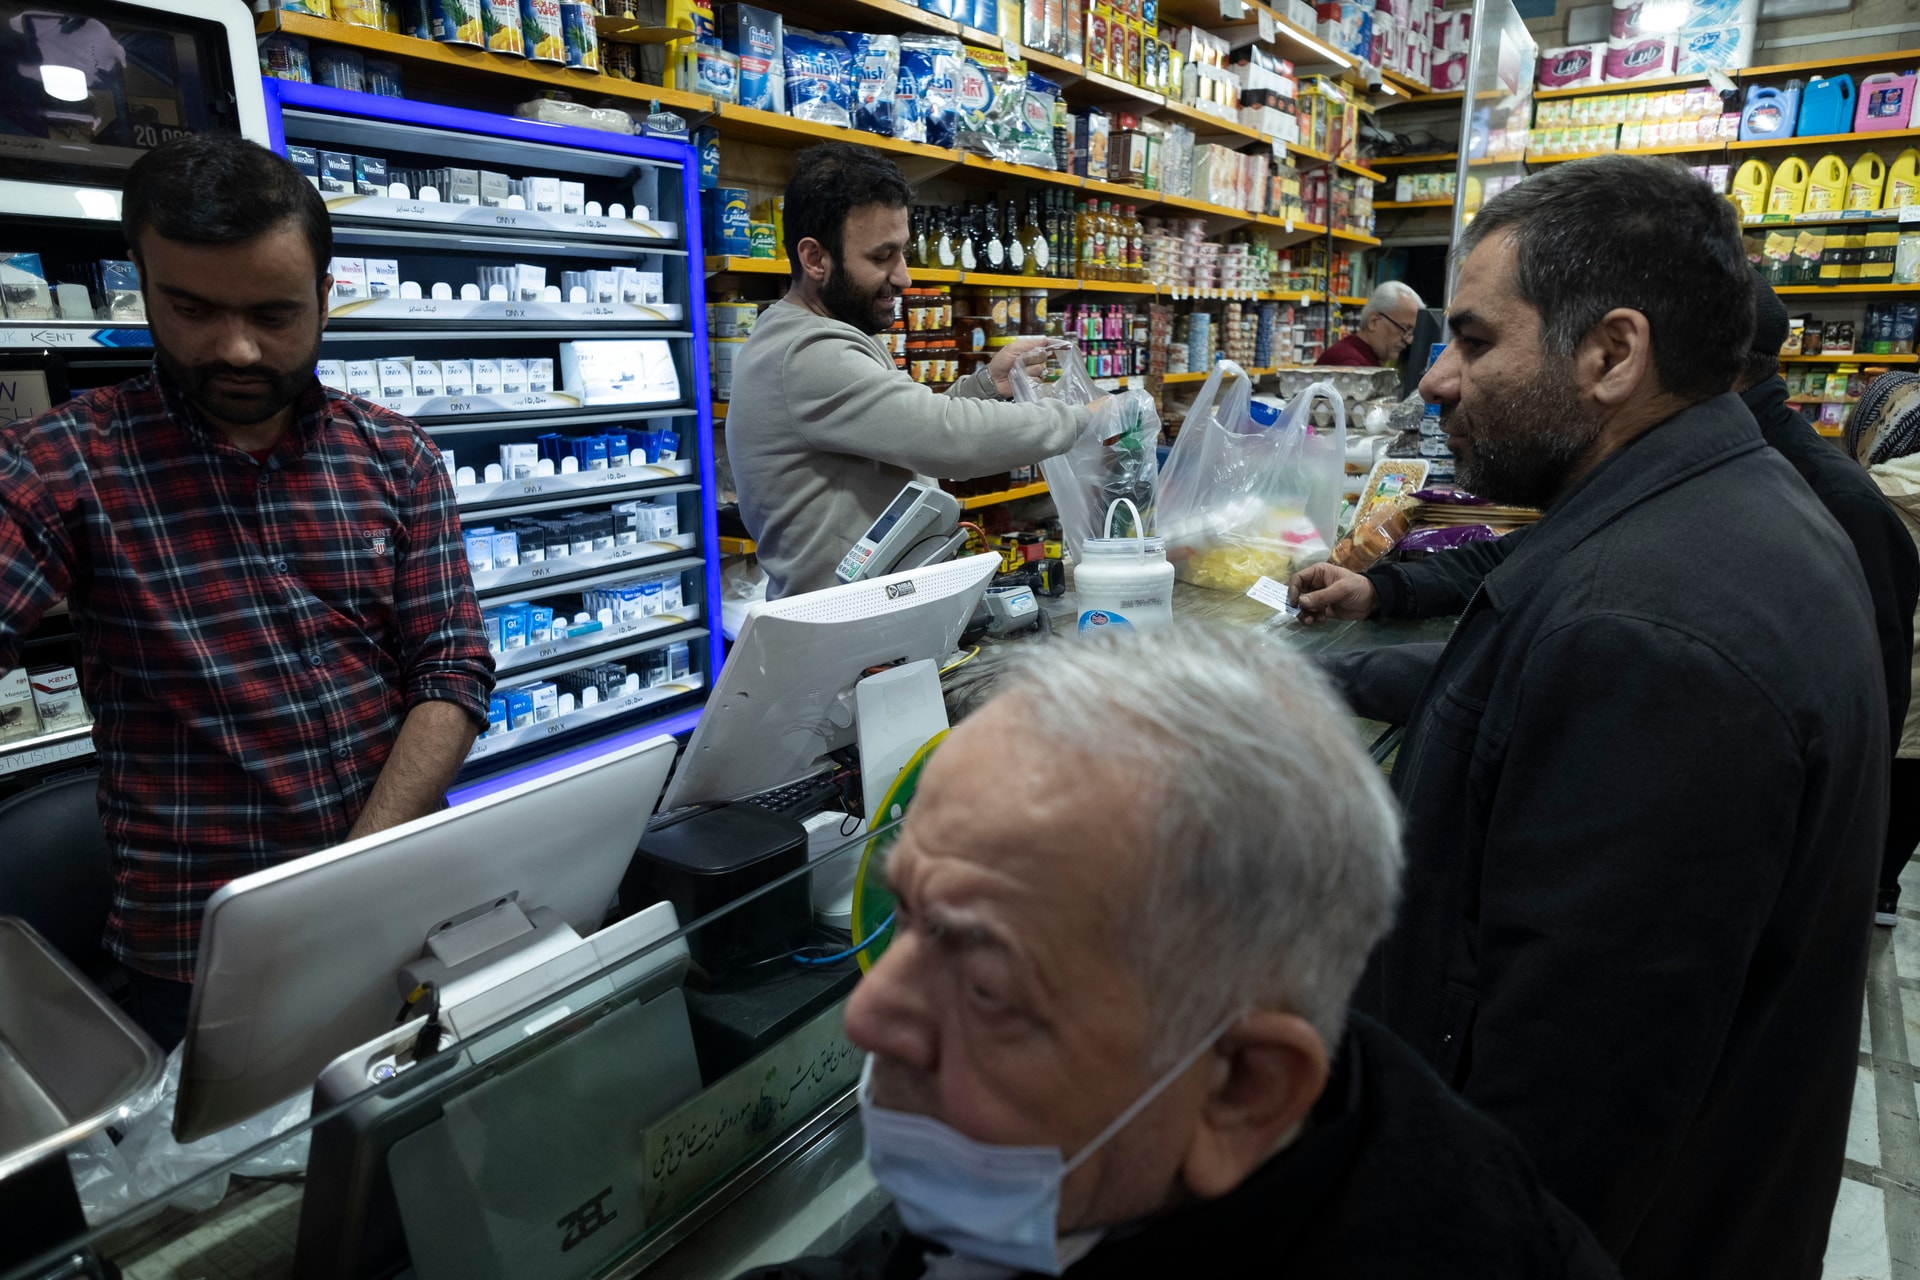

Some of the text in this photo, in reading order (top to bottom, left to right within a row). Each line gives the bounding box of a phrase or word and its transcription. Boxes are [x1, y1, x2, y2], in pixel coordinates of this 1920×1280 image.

[749, 25, 775, 46] finish
[799, 54, 840, 79] finish
[134, 125, 157, 147] 20
[291, 153, 315, 165] Winston
[328, 159, 350, 170] Winston
[363, 163, 385, 175] Winston
[106, 264, 133, 278] KENT
[341, 264, 363, 273] Winston
[375, 266, 397, 275] Winston
[30, 330, 76, 347] KENT
[450, 403, 472, 411] ONYX
[363, 528, 391, 538] GANT
[534, 612, 544, 621] G1
[507, 620, 517, 629] G1
[47, 673, 73, 684] KENT
